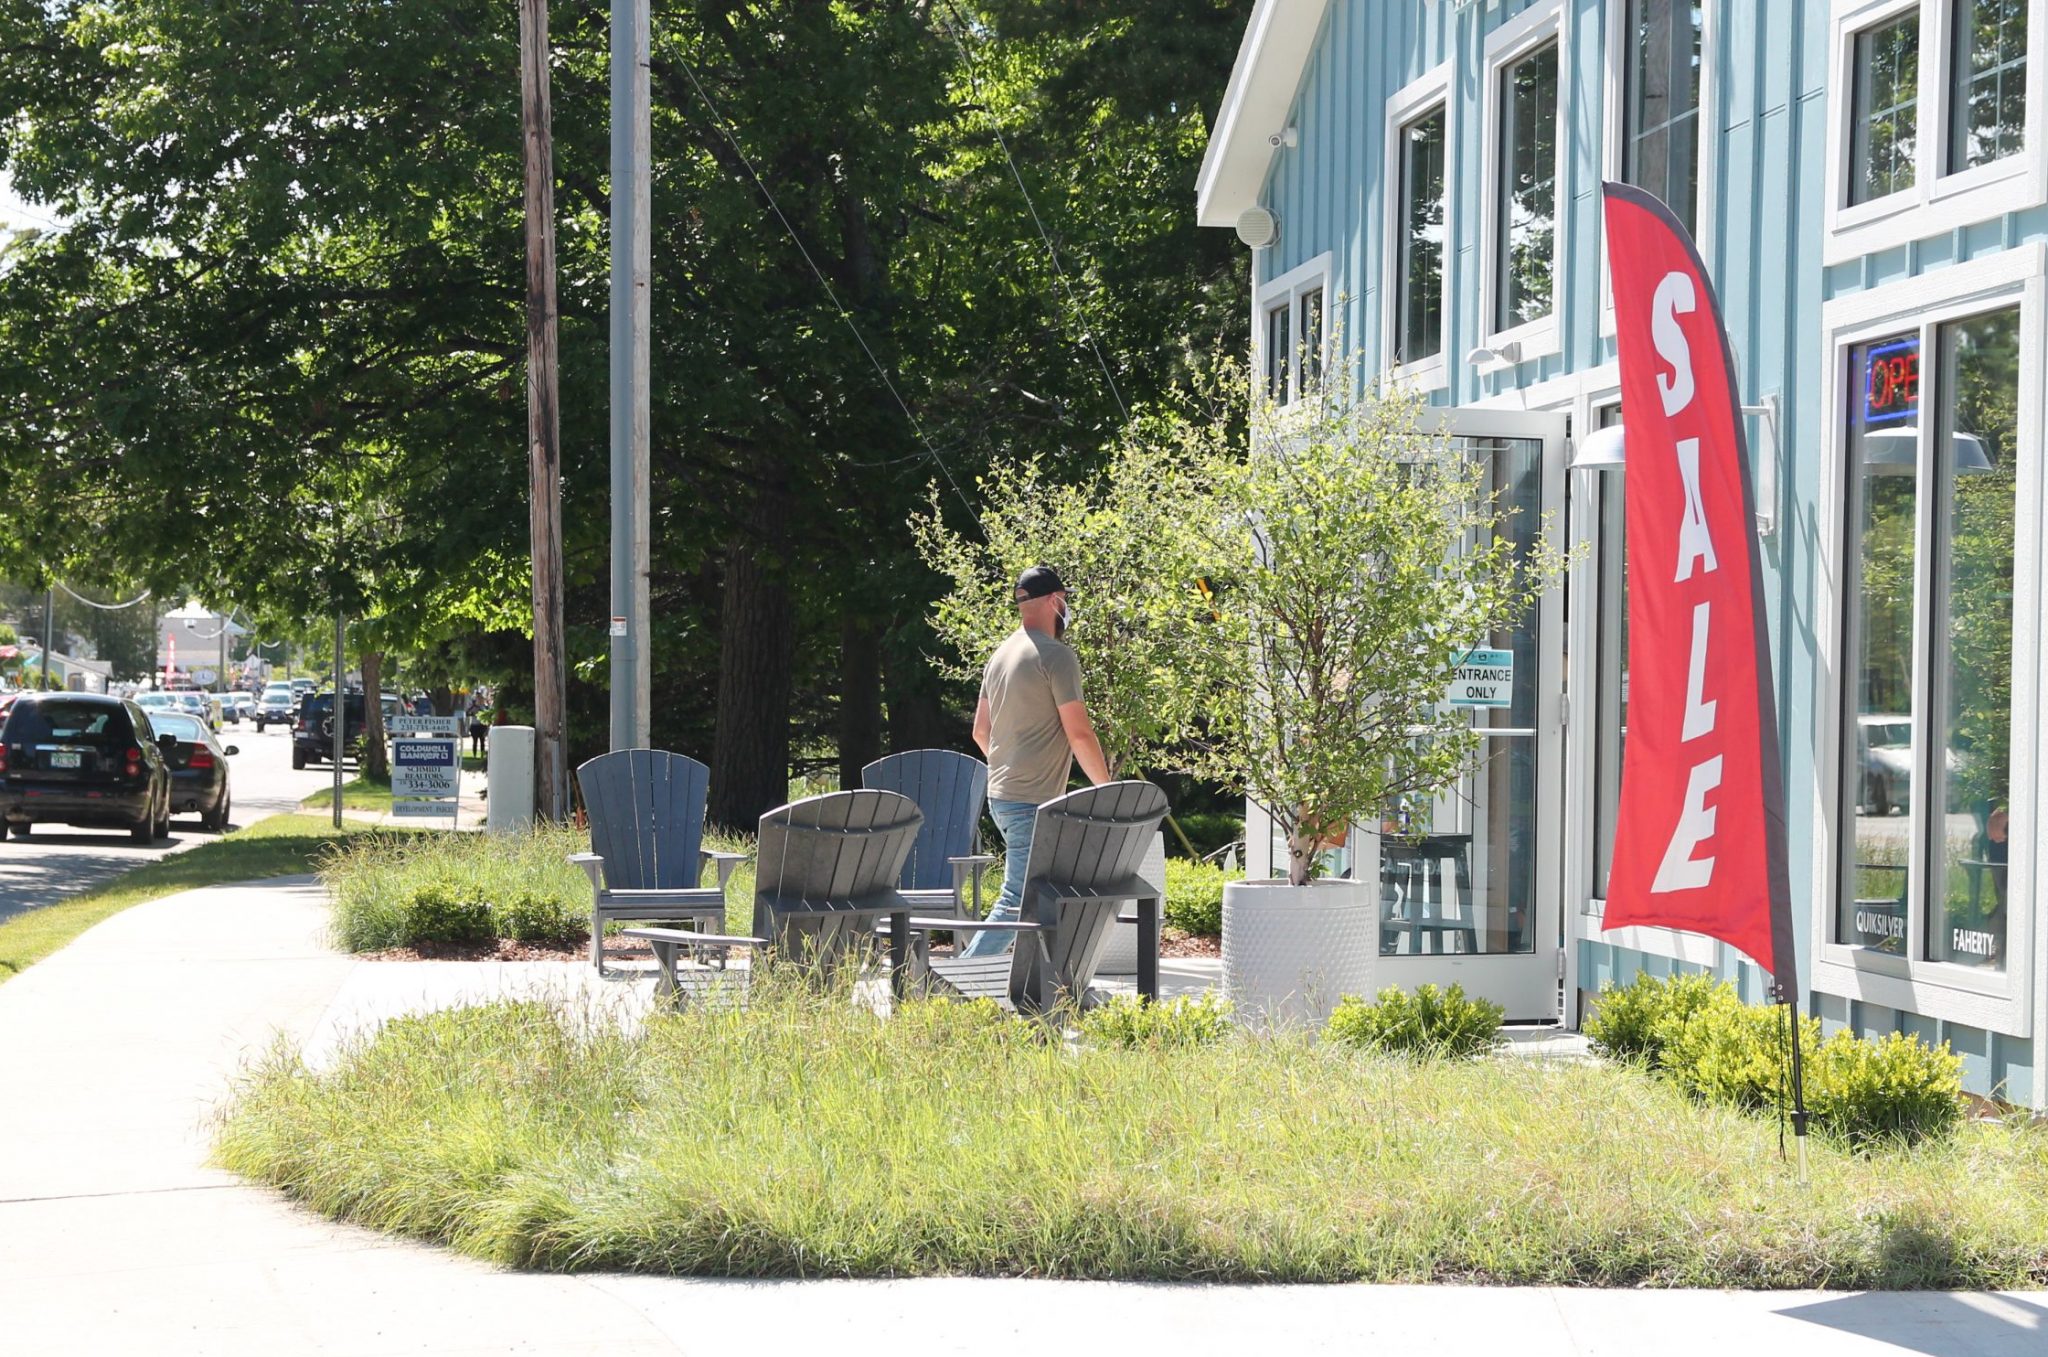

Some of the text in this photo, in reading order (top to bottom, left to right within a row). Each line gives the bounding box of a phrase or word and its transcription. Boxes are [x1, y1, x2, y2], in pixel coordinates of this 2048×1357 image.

[1871, 354, 1919, 409] OPE
[1650, 271, 1723, 894] SALE
[1452, 668, 1511, 681] ENTRANCE
[1466, 686, 1497, 698] ONLY
[400, 745, 449, 753] COLDWELL
[400, 752, 440, 760] BANKER
[409, 780, 450, 789] 334-3006
[1856, 911, 1904, 938] QUIKSILVER
[1953, 928, 1994, 956] FAHERTY
